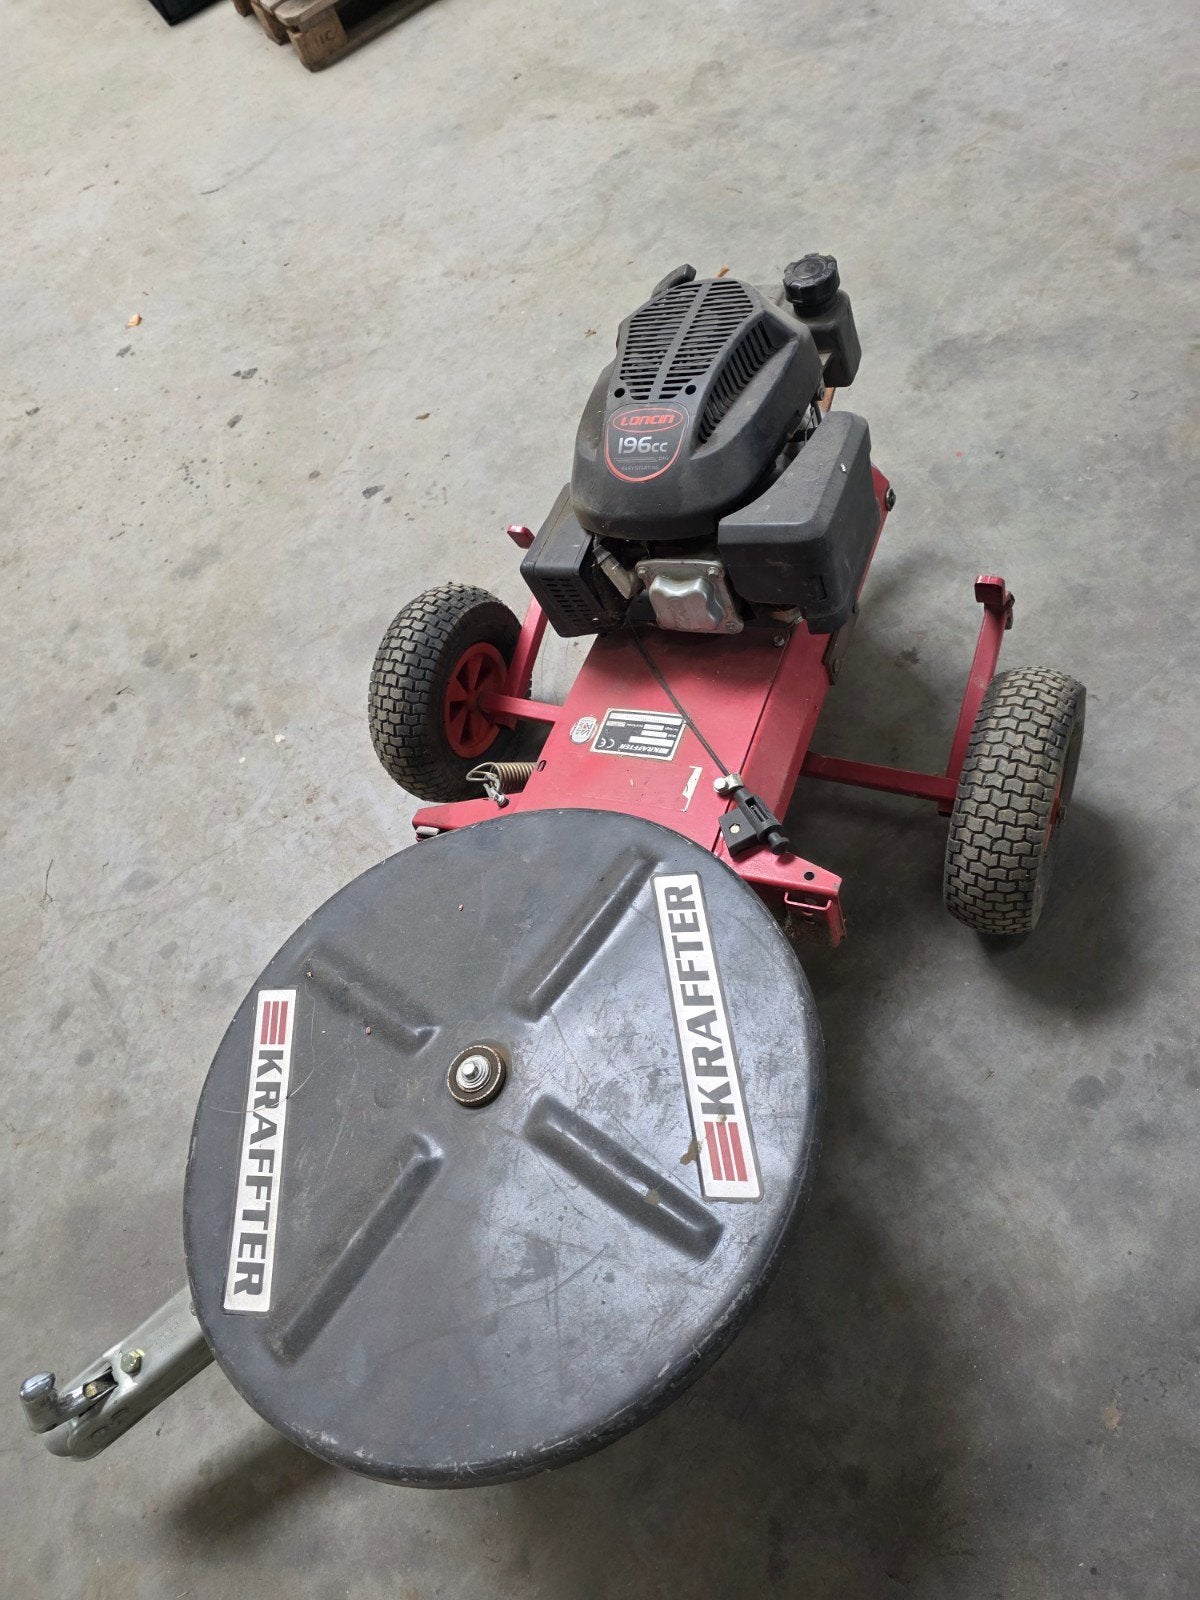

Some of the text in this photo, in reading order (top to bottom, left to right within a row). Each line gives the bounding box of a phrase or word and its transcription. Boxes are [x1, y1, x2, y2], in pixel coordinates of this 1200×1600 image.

[617, 436, 669, 454] 196cc
[619, 743, 660, 754] KRAFFTER
[664, 884, 735, 1115] KRAFFTER
[233, 1049, 284, 1296] KRAFFTER
